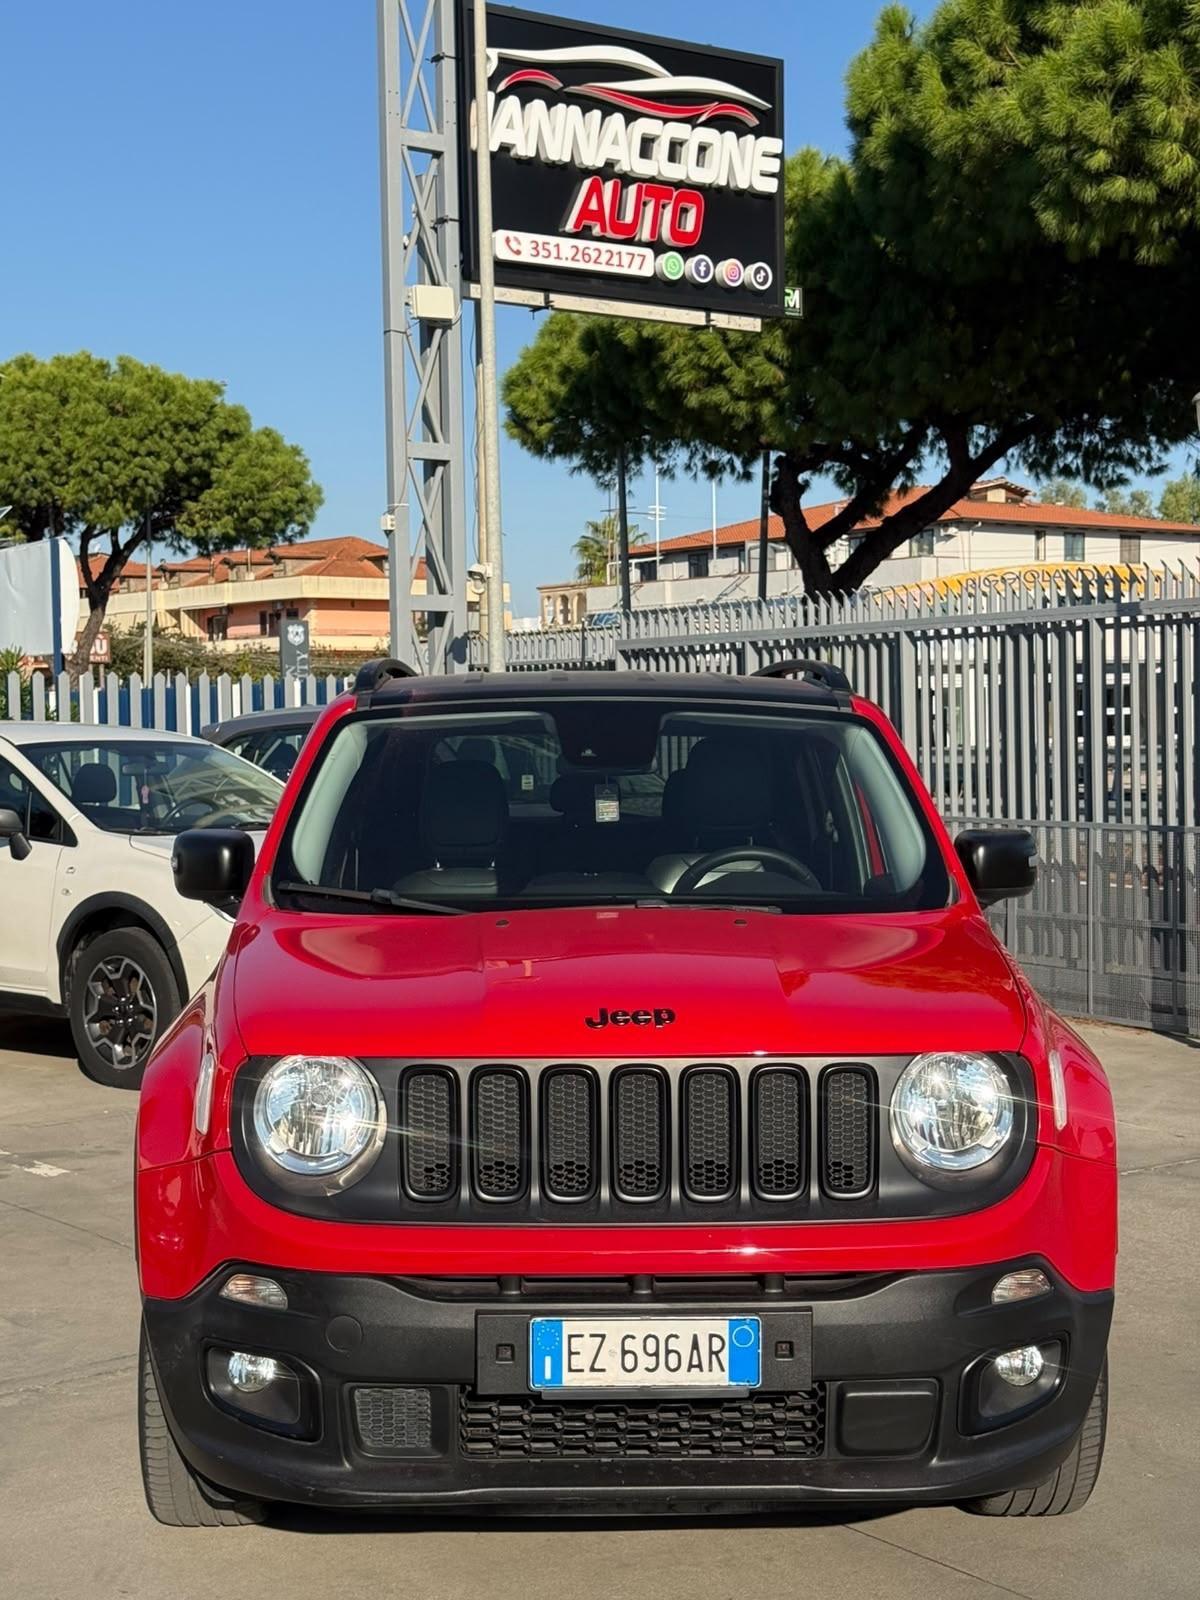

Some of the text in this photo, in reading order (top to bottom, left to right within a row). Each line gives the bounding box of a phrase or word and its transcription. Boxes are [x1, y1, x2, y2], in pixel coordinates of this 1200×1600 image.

[565, 176, 705, 247] AUTO
[529, 240, 646, 271] 351.2622177
[584, 1007, 676, 1029] Jeep
[567, 1333, 726, 1373] EZ 696AR
